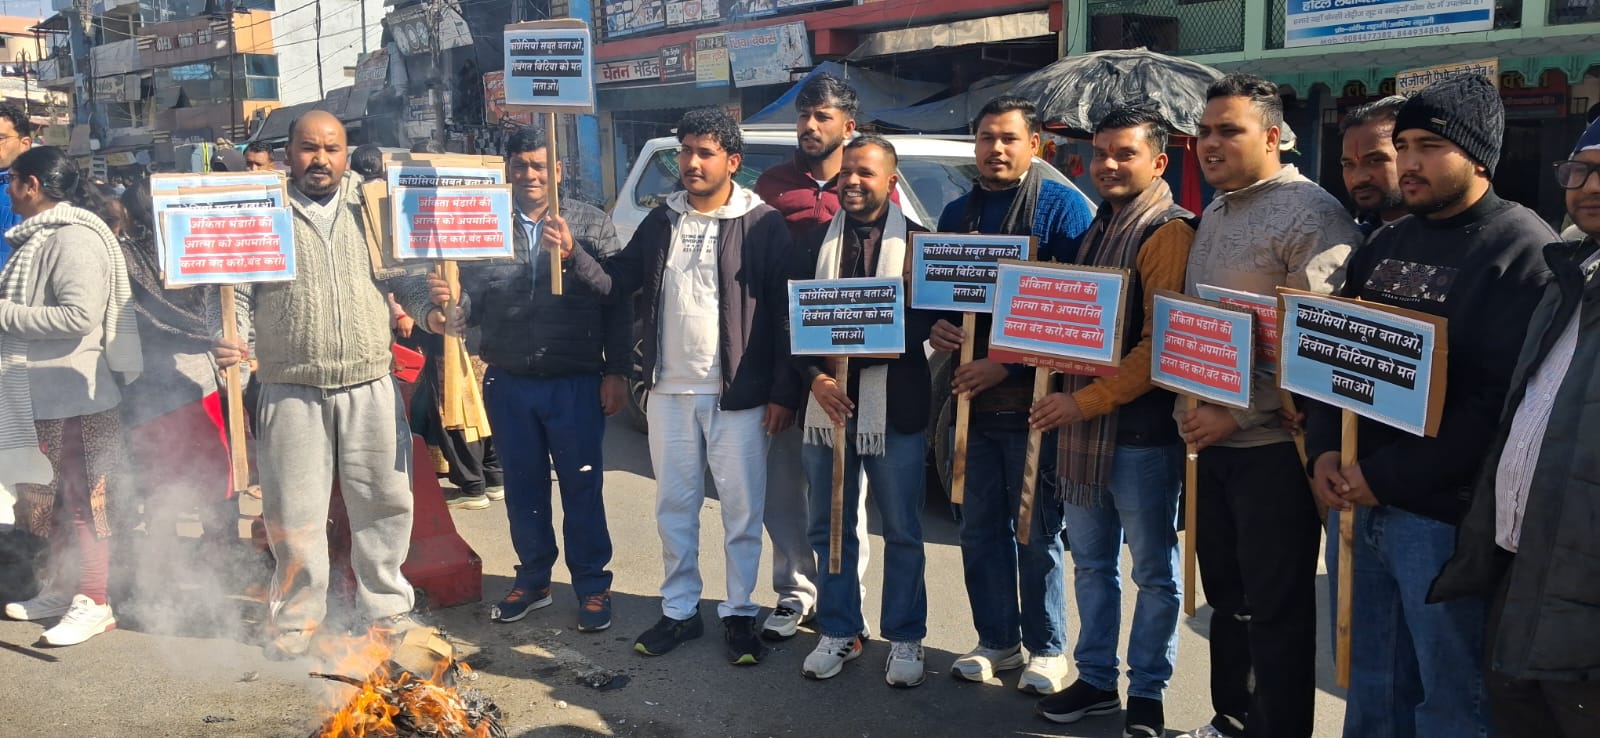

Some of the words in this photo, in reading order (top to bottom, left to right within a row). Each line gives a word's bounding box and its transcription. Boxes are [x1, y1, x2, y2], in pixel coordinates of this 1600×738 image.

[559, 60, 569, 71] को
[571, 62, 582, 71] मत
[602, 63, 630, 80] चेतन
[634, 61, 660, 77] मेडिक
[1400, 72, 1432, 88] संजीवनी
[419, 197, 448, 207] अंकिता
[452, 196, 476, 206] भंडारी
[478, 196, 491, 206] की
[191, 218, 225, 229] अंकिता
[258, 216, 272, 227] की
[442, 214, 454, 225] को
[457, 214, 498, 225] अपमानित
[185, 238, 215, 249] आत्मा
[218, 235, 231, 248] को
[235, 235, 280, 247] अपमानित
[923, 244, 962, 256] कांग्रेसियों
[964, 247, 985, 260] सबूत
[988, 245, 1021, 259] बताओ,
[180, 258, 205, 269] करना
[926, 264, 954, 276] दिवंगत
[956, 265, 985, 278] बिटिया
[988, 268, 997, 278] क
[953, 284, 986, 297] सताओ।
[1020, 277, 1052, 291] अंकिता
[1055, 278, 1081, 293] भंडारी
[1083, 282, 1098, 295] की
[799, 287, 838, 300] कांग्रेसियों
[840, 289, 861, 303] सबूत
[863, 286, 896, 299] बताओ,
[801, 309, 831, 320] दिवंगत
[833, 308, 863, 320] बिटिया
[865, 308, 878, 319] को
[880, 309, 894, 318] मत
[1011, 299, 1038, 310] आत्मा
[1040, 301, 1053, 313] को
[1056, 304, 1102, 319] अपमानित
[1170, 309, 1194, 326] अंकिता
[1196, 316, 1218, 331] भंडारी
[1220, 321, 1232, 335] की
[831, 328, 864, 340] सताओ।
[1005, 320, 1026, 331] करना
[1029, 322, 1042, 334] बंद
[1081, 328, 1104, 341] करो।
[1298, 308, 1348, 330] कांग्रेसियों
[1348, 320, 1376, 342] सबूत
[1379, 328, 1422, 353] बताओ,
[1165, 334, 1185, 346] आत्मा
[1186, 337, 1198, 350] को
[1200, 344, 1238, 360] अपमानित
[1299, 334, 1333, 356] दिवंगत
[1336, 345, 1375, 368] बिटिया
[1377, 358, 1395, 374] को
[1397, 367, 1416, 381] मत
[1160, 356, 1177, 368] करना
[1179, 360, 1189, 372] बंद
[1221, 369, 1241, 386] करो।
[1332, 374, 1374, 397] सताओ।
